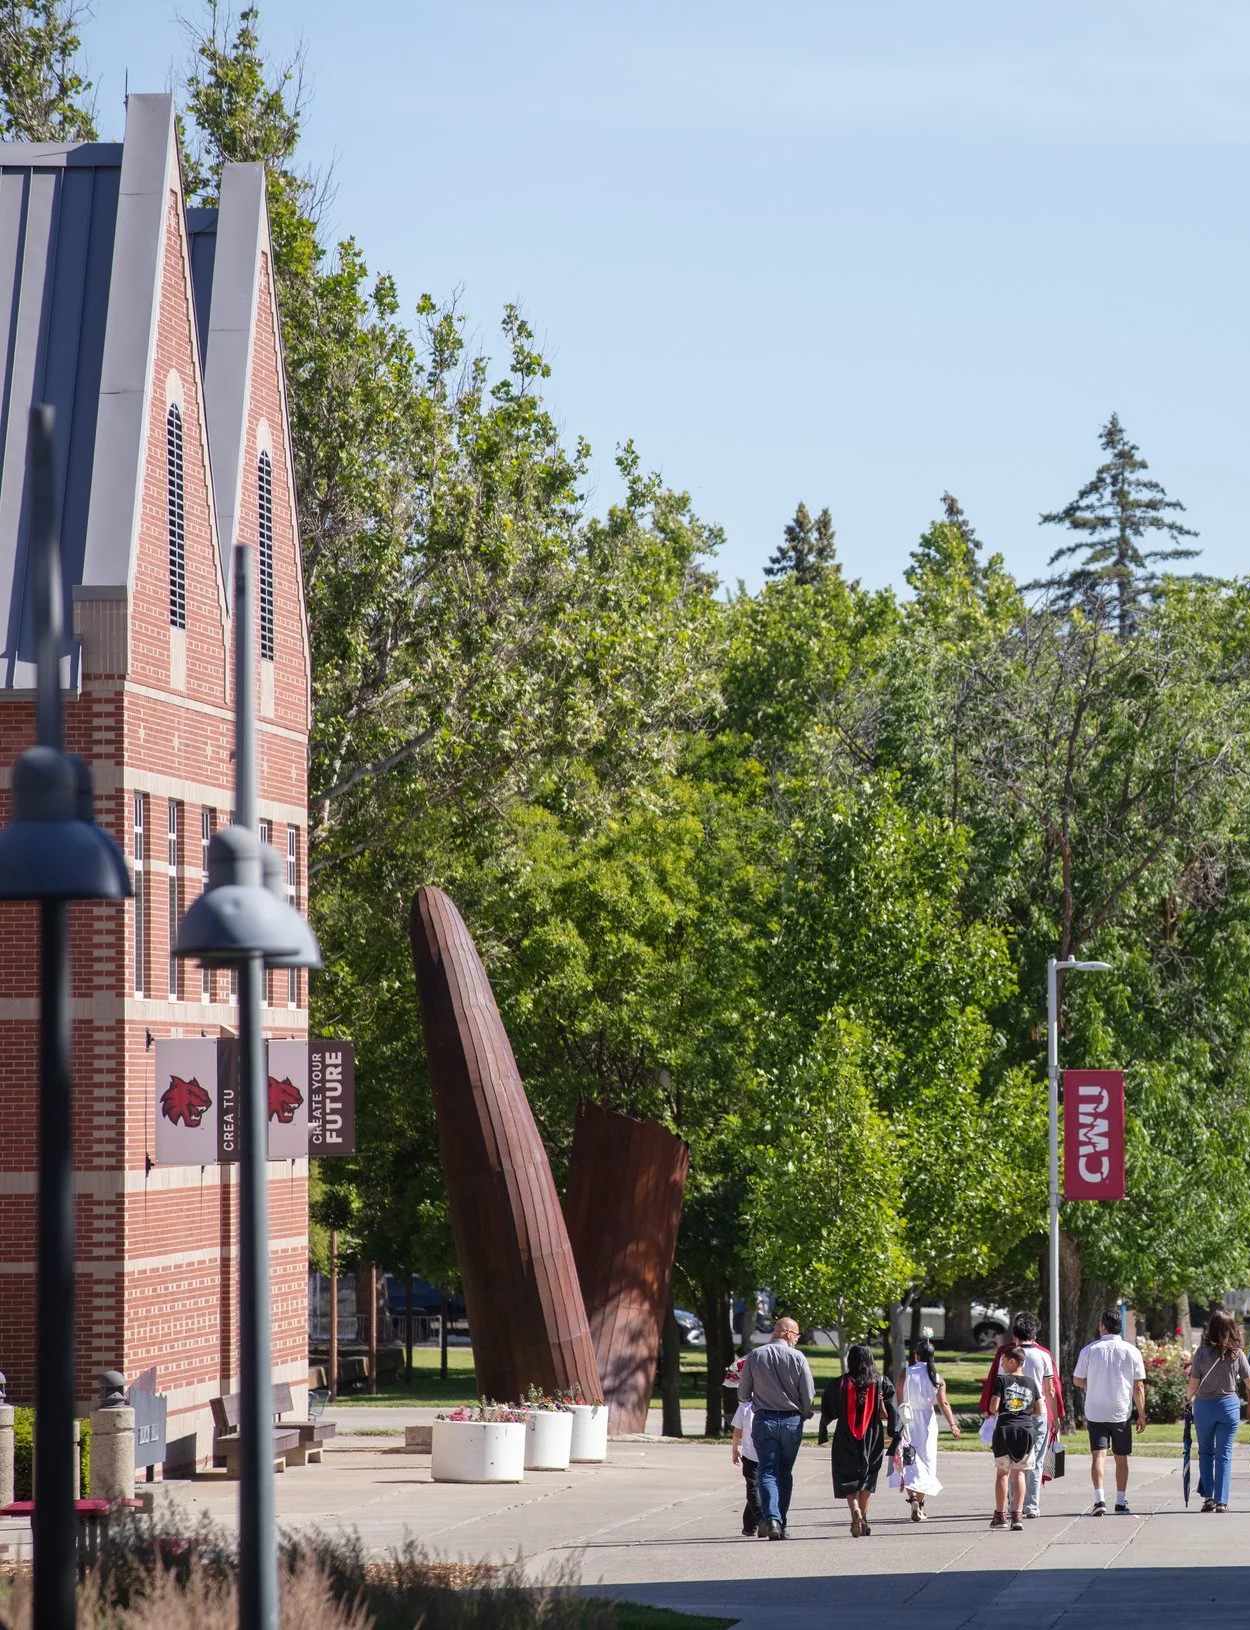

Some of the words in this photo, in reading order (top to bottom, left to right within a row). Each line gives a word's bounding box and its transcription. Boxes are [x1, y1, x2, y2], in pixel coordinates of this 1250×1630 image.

[311, 1053, 323, 1089] YOUR
[223, 1089, 235, 1113] TU
[311, 1093, 323, 1145] CREATE
[325, 1051, 343, 1144] FUTURE
[223, 1114, 235, 1152] CREA
[1078, 1085, 1110, 1183] CWU
